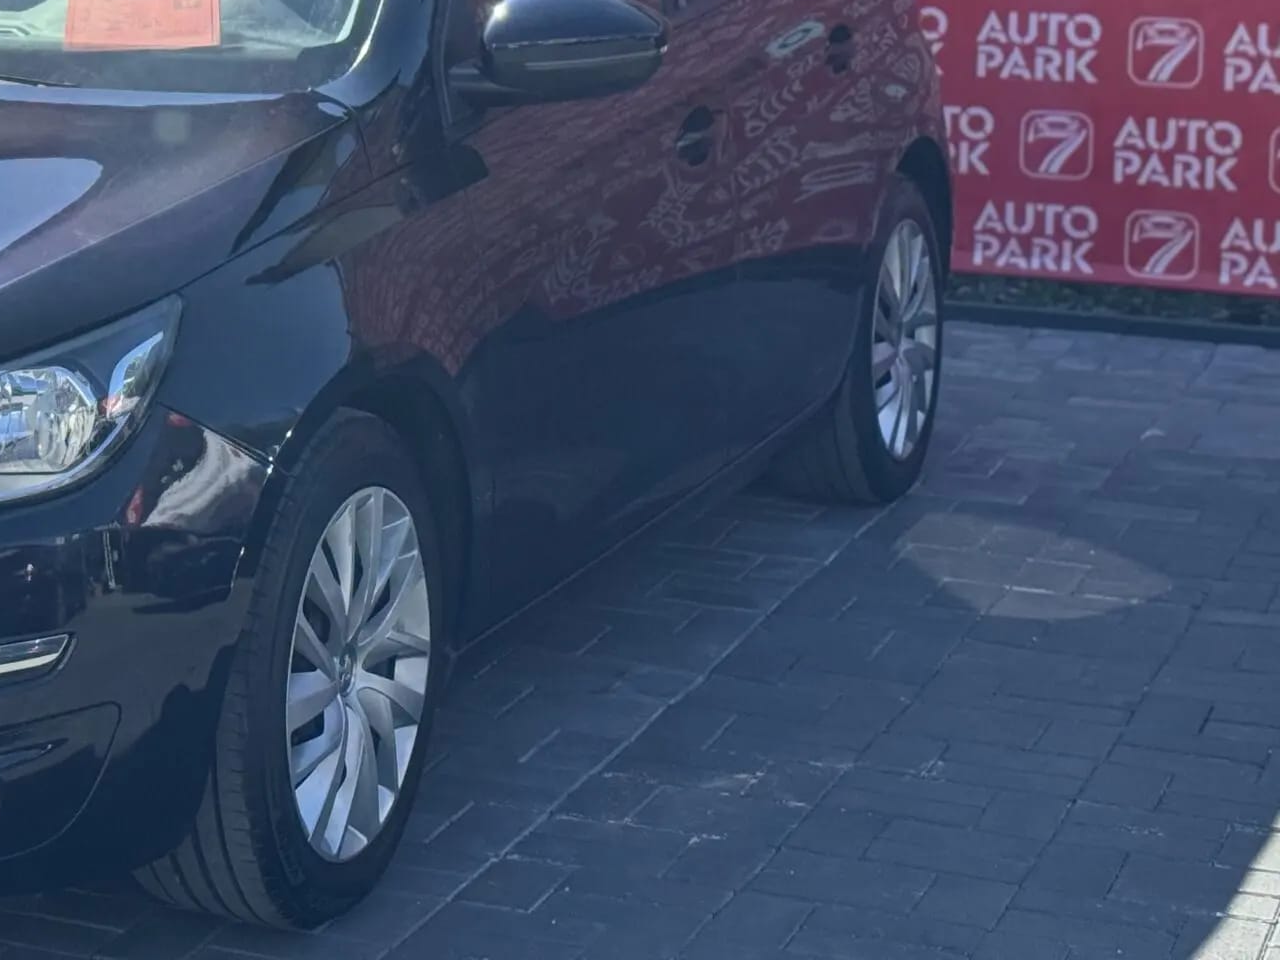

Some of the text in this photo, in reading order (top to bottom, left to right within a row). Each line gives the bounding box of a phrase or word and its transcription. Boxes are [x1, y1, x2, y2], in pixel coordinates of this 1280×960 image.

[977, 9, 1102, 47] AUTO
[976, 46, 1098, 84] PARK
[1114, 116, 1242, 156] AUTO
[1113, 153, 1237, 191] PARK
[974, 199, 1098, 239] AUTO
[972, 238, 1094, 274] PARK
